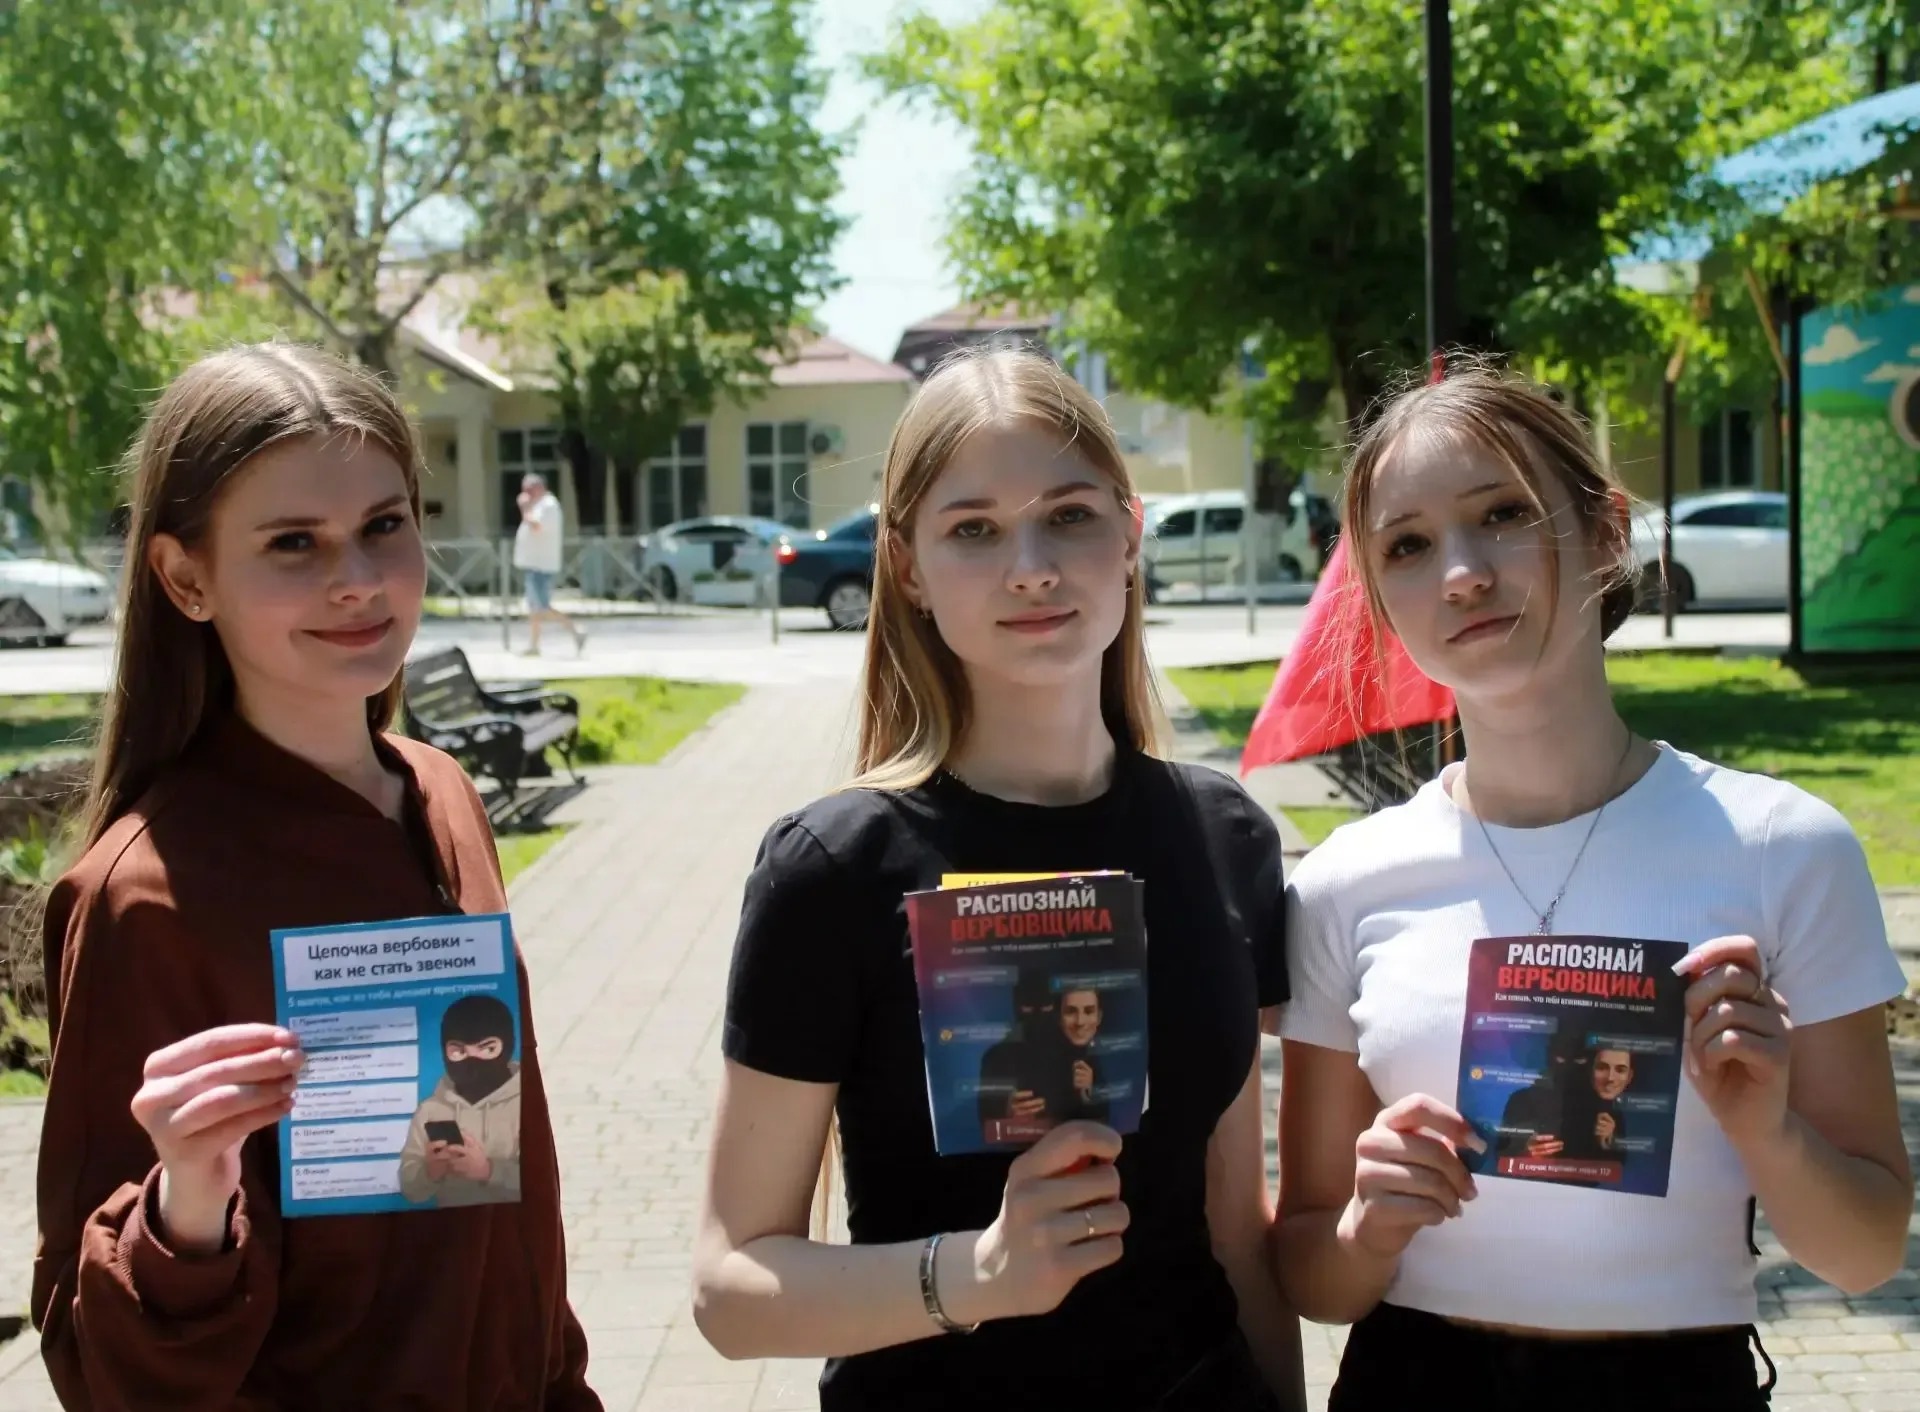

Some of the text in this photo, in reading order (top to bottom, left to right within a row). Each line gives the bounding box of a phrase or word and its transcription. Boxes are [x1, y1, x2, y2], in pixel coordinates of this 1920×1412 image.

[956, 885, 1096, 916] РАСПОЗНАЙ
[952, 909, 1113, 941] ВЕРБОВЩИКА
[308, 942, 378, 960] Цепочка
[383, 936, 460, 956] вербовки
[1507, 943, 1644, 973] РАСПОЗНАЙ
[315, 956, 476, 981] как не стать звеном
[1498, 965, 1656, 999] ВЕРБОВЩИКА
